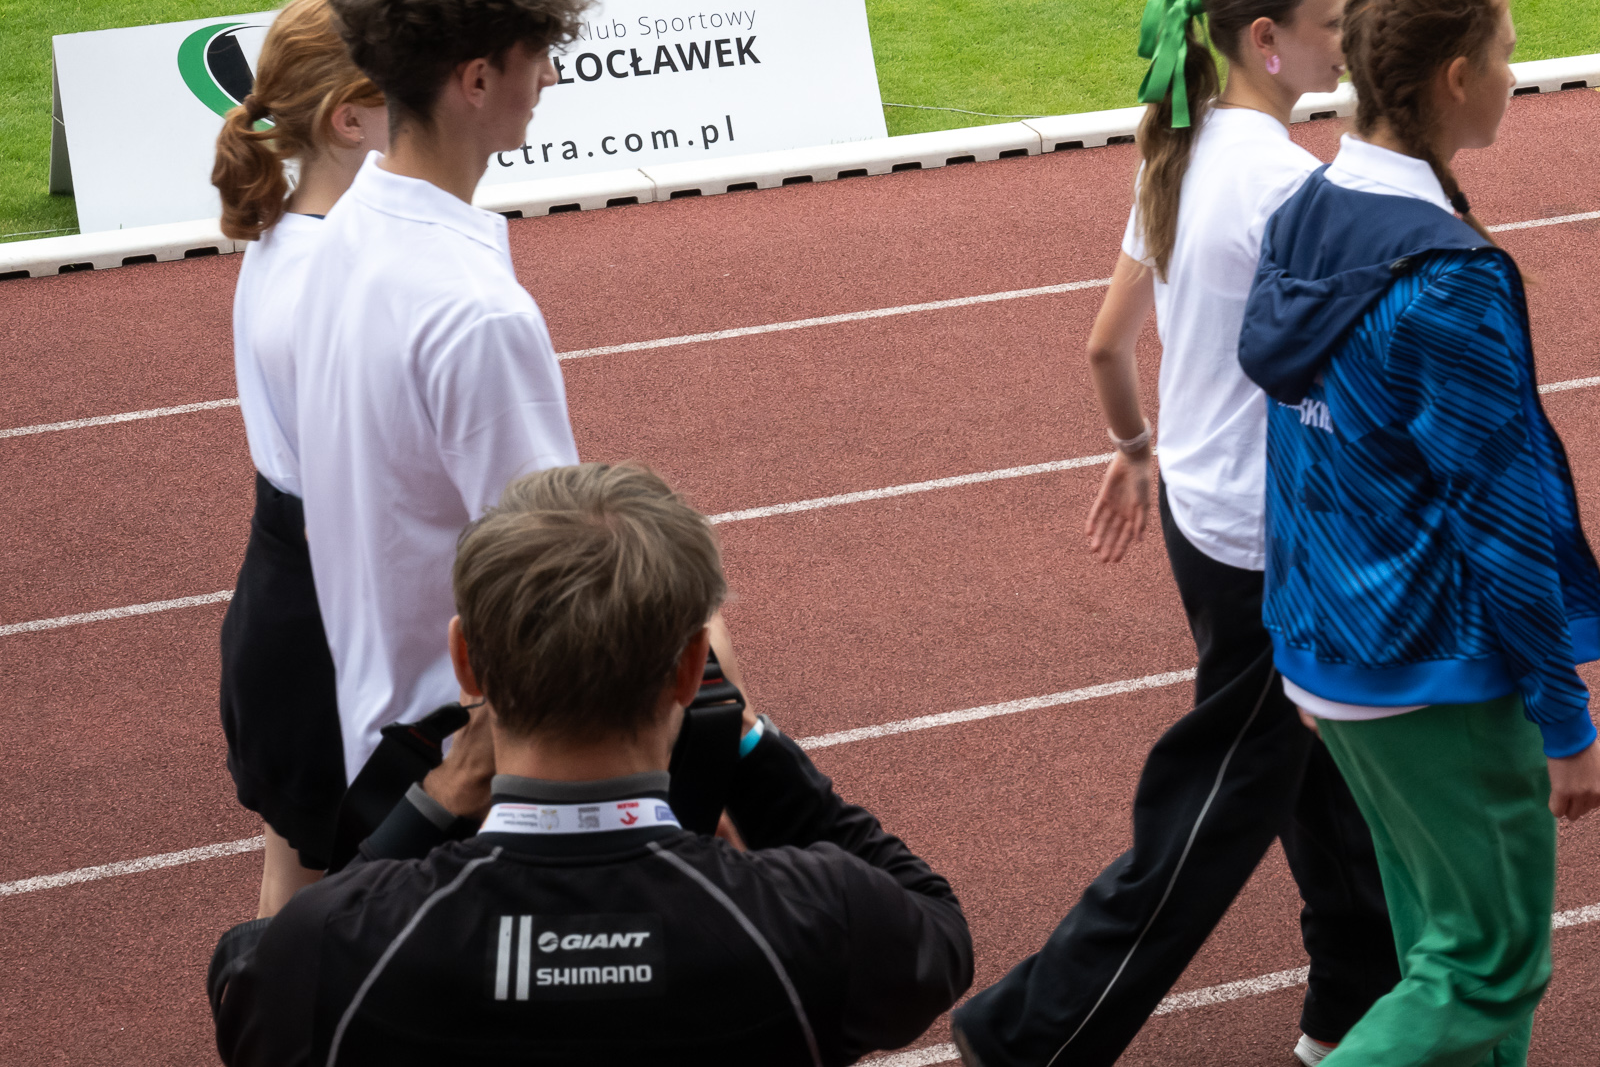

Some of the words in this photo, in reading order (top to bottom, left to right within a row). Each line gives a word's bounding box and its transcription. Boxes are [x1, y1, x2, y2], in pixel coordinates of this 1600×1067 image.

[638, 10, 756, 39] Sportowy
[553, 35, 761, 85] ŁOCŁAWEK
[496, 115, 735, 166] ctra.com.pl
[560, 932, 650, 950] GIANT
[536, 965, 652, 986] SHIMANO
